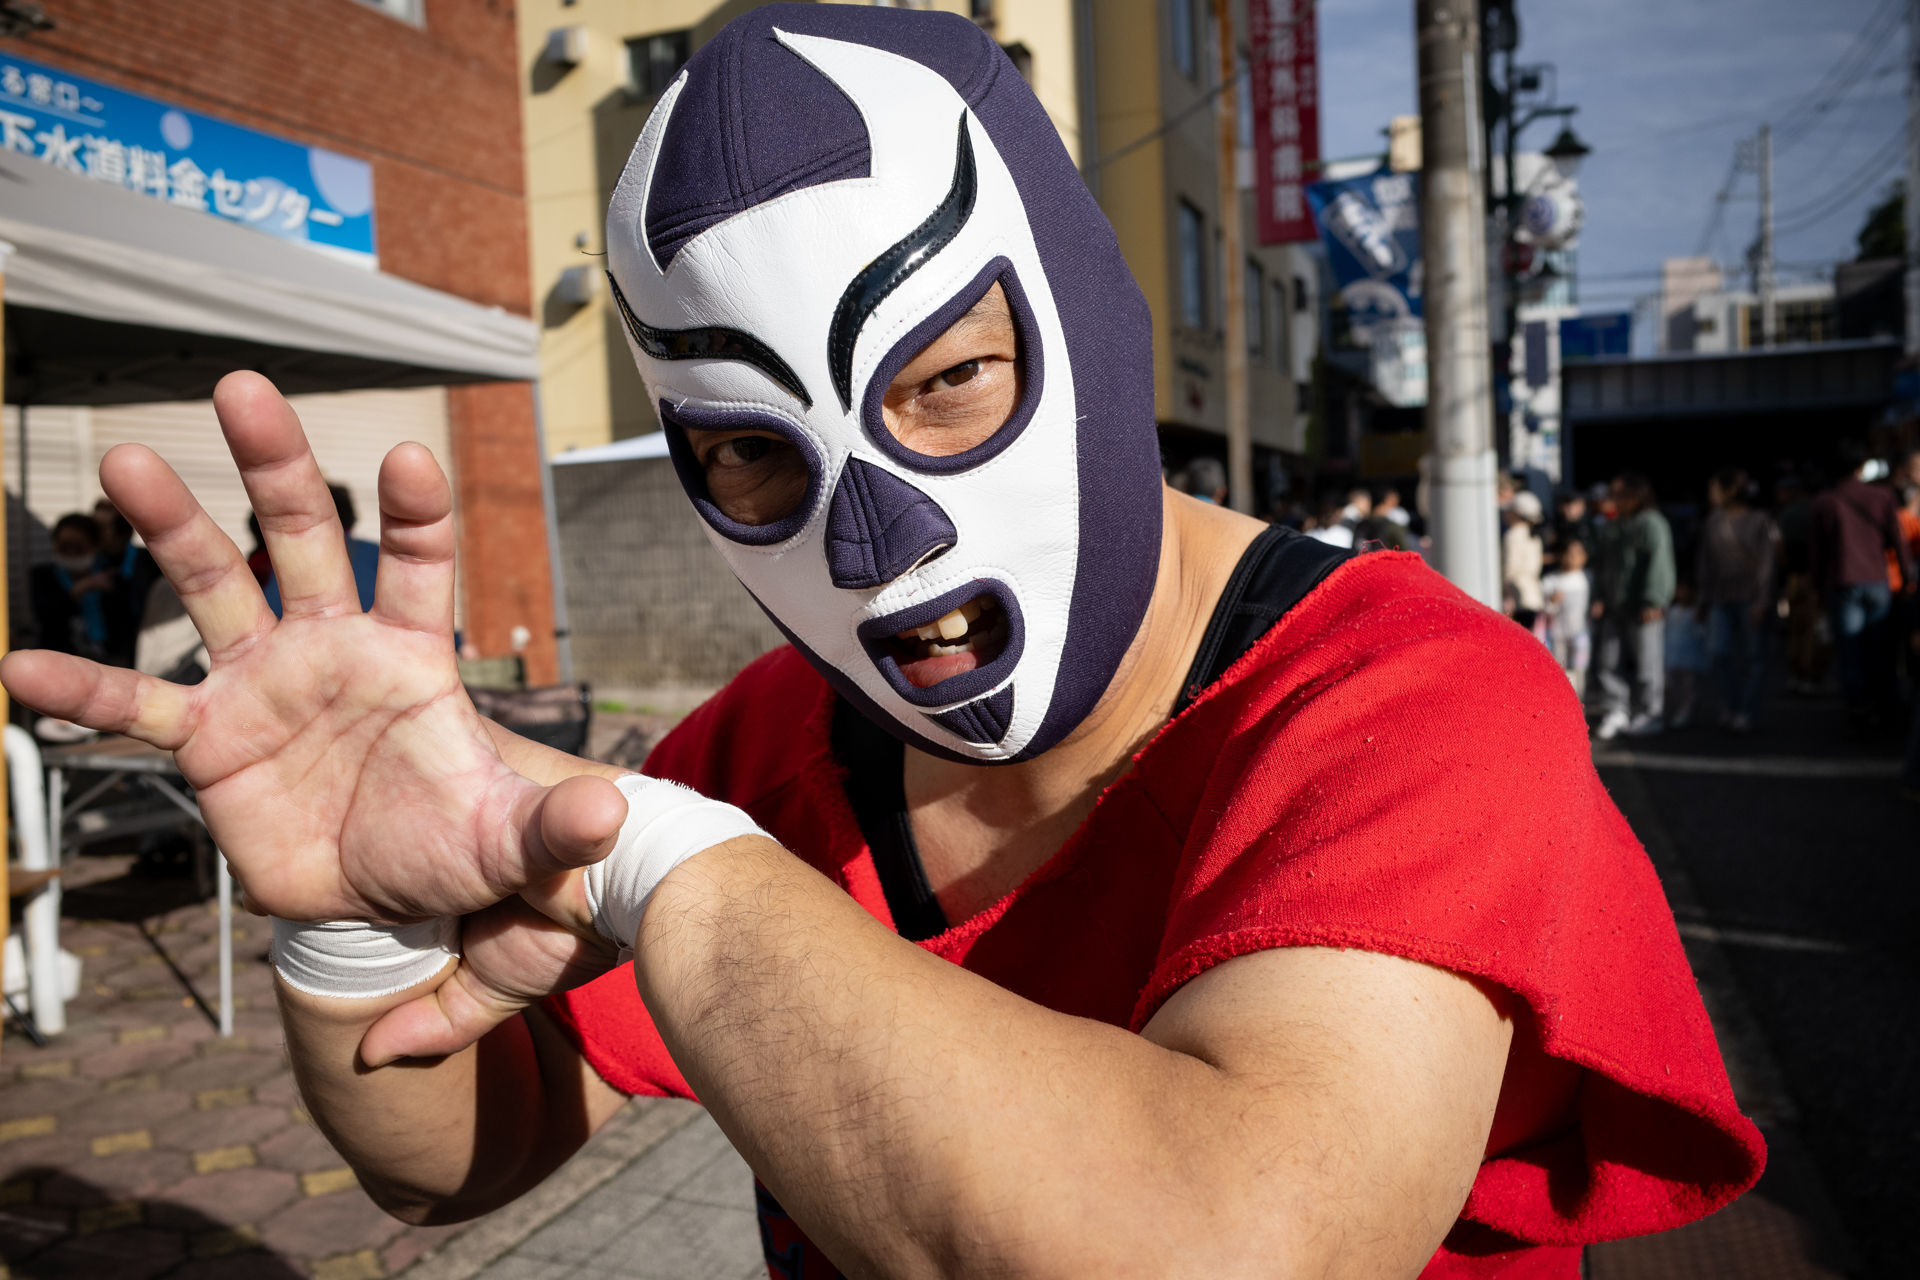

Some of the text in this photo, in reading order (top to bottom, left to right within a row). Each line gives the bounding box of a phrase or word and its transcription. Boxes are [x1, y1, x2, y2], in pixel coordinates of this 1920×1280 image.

[0, 110, 345, 229] 下水道料金センター
